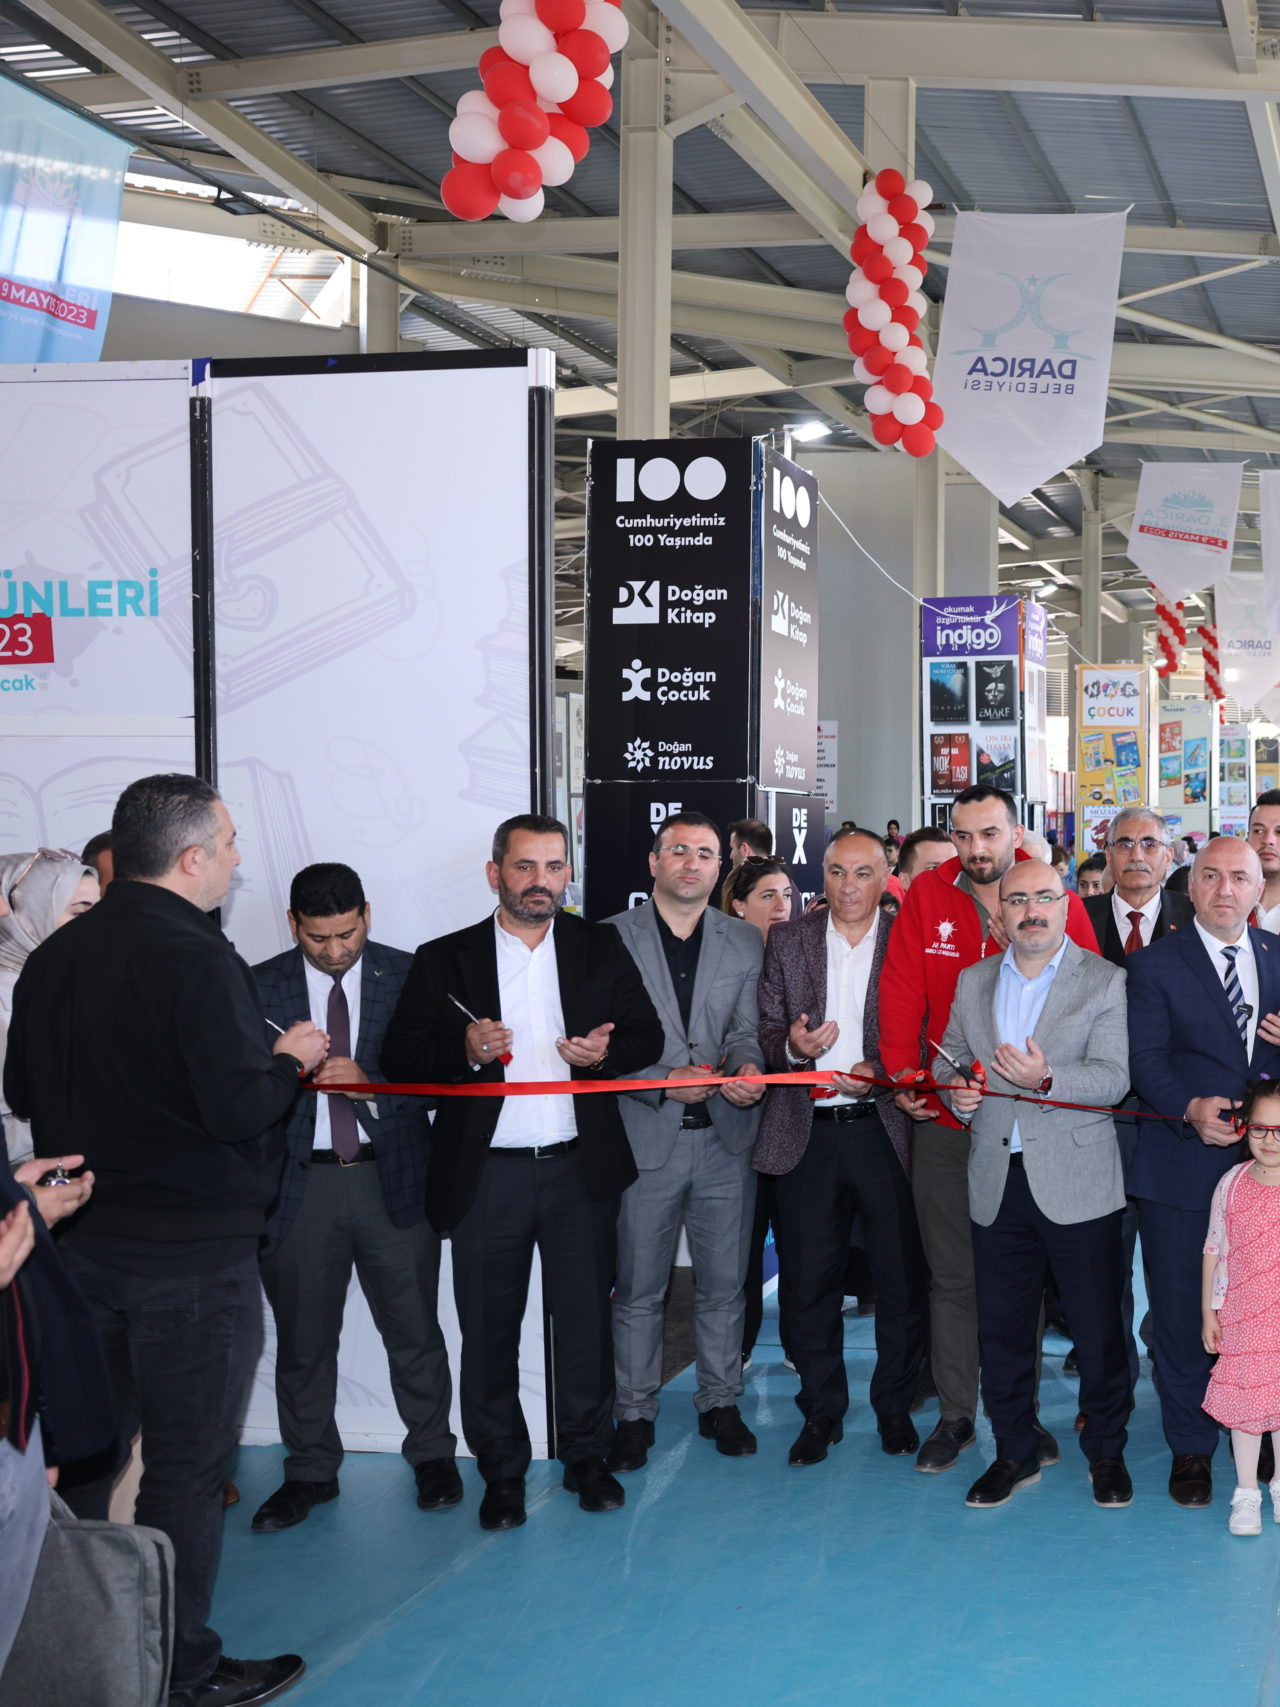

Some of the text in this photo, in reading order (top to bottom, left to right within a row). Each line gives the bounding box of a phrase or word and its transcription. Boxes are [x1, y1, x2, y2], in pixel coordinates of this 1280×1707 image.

[616, 457, 727, 502] 100
[773, 467, 811, 528] 100
[616, 513, 726, 530] Cumhuriyetimiz
[628, 532, 713, 549] 100 Yaşında
[0, 568, 159, 618] ÜNLERİ
[667, 584, 728, 605] Doğan
[667, 606, 717, 628] Kitap
[790, 602, 812, 625] Doğan
[943, 605, 975, 613] okumak
[790, 624, 808, 647] Kitap
[936, 625, 999, 650] indigo
[657, 667, 717, 686] Doğan
[656, 685, 711, 706] Çocuk
[786, 680, 807, 700] Doğan
[1088, 706, 1135, 720] ÇOCUK
[658, 741, 692, 753] Doğan
[658, 756, 714, 770] novus
[785, 763, 806, 780] novus
